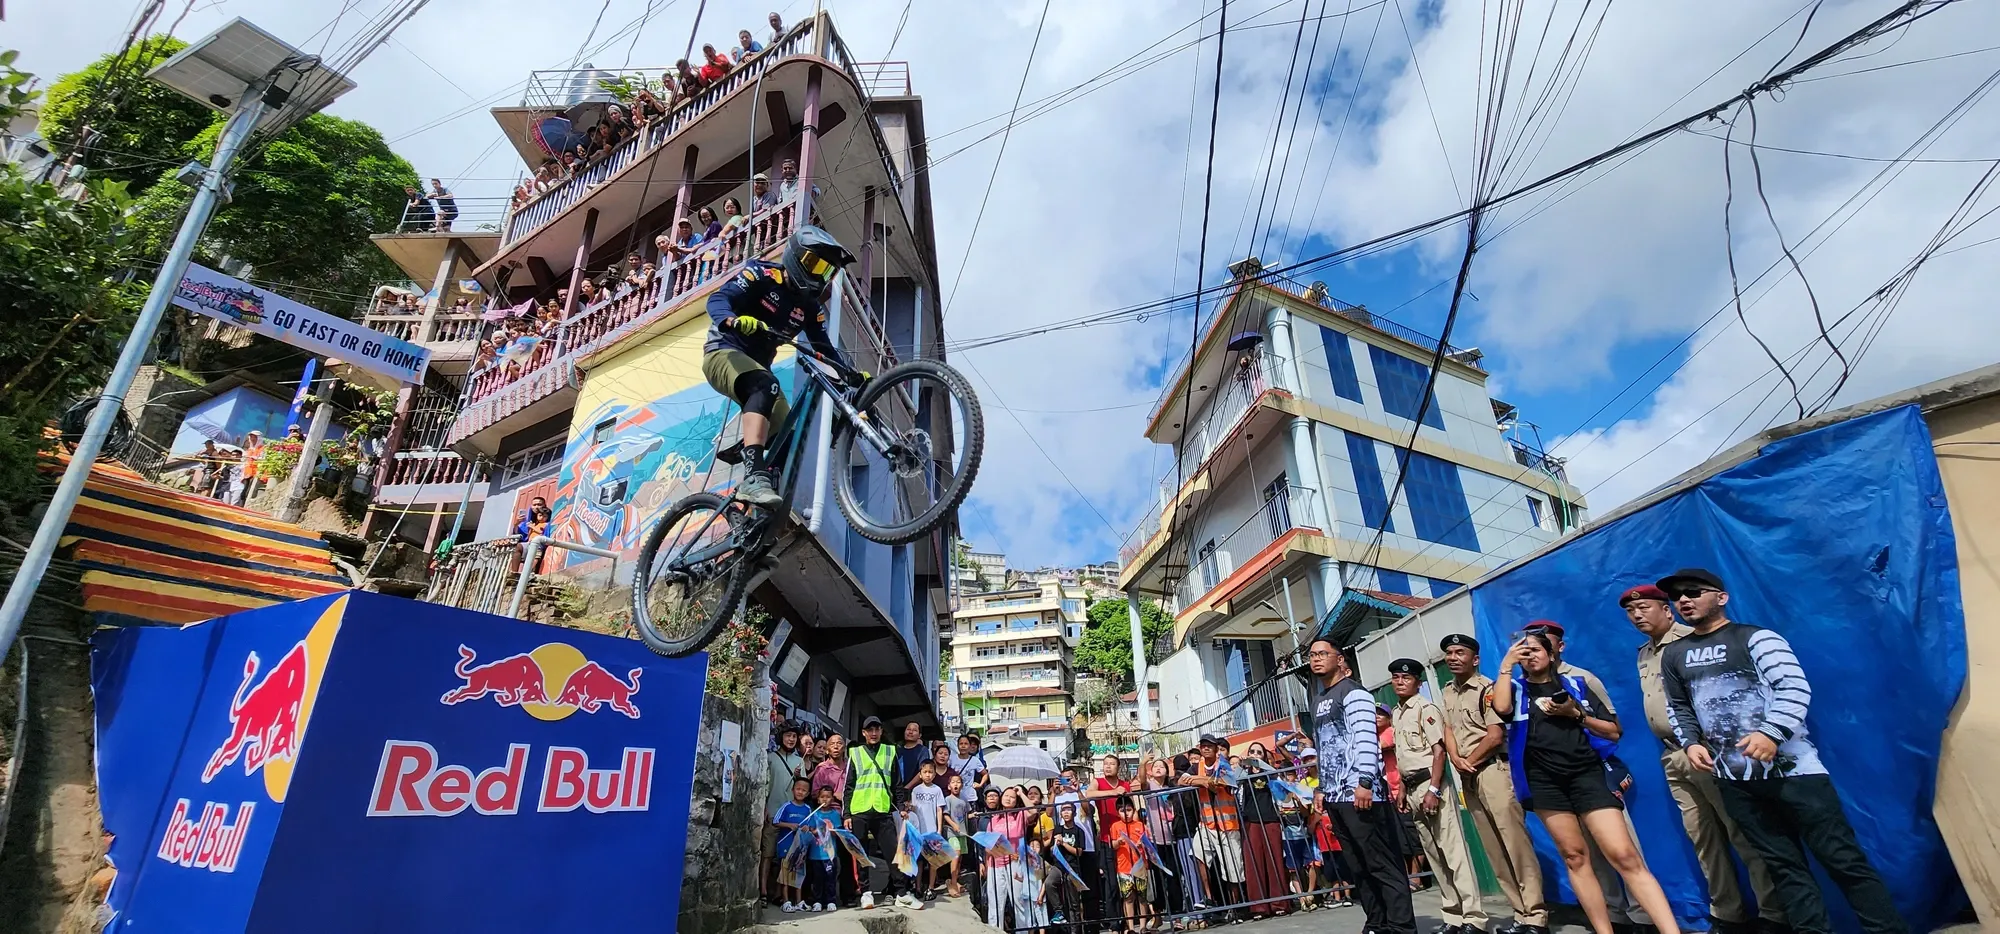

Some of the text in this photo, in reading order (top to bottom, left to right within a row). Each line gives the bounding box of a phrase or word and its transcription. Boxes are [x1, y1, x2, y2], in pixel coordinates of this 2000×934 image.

[272, 309, 296, 330] GO
[298, 317, 339, 344] FAST
[339, 333, 360, 352] OR
[361, 339, 382, 359] GO
[383, 347, 425, 373] HOME
[936, 370, 963, 399] MAXXIS
[633, 571, 642, 609] MAXXIS
[1685, 644, 1727, 664] NAC
[368, 741, 655, 815] Red Bull
[158, 799, 255, 872] Red Bull
